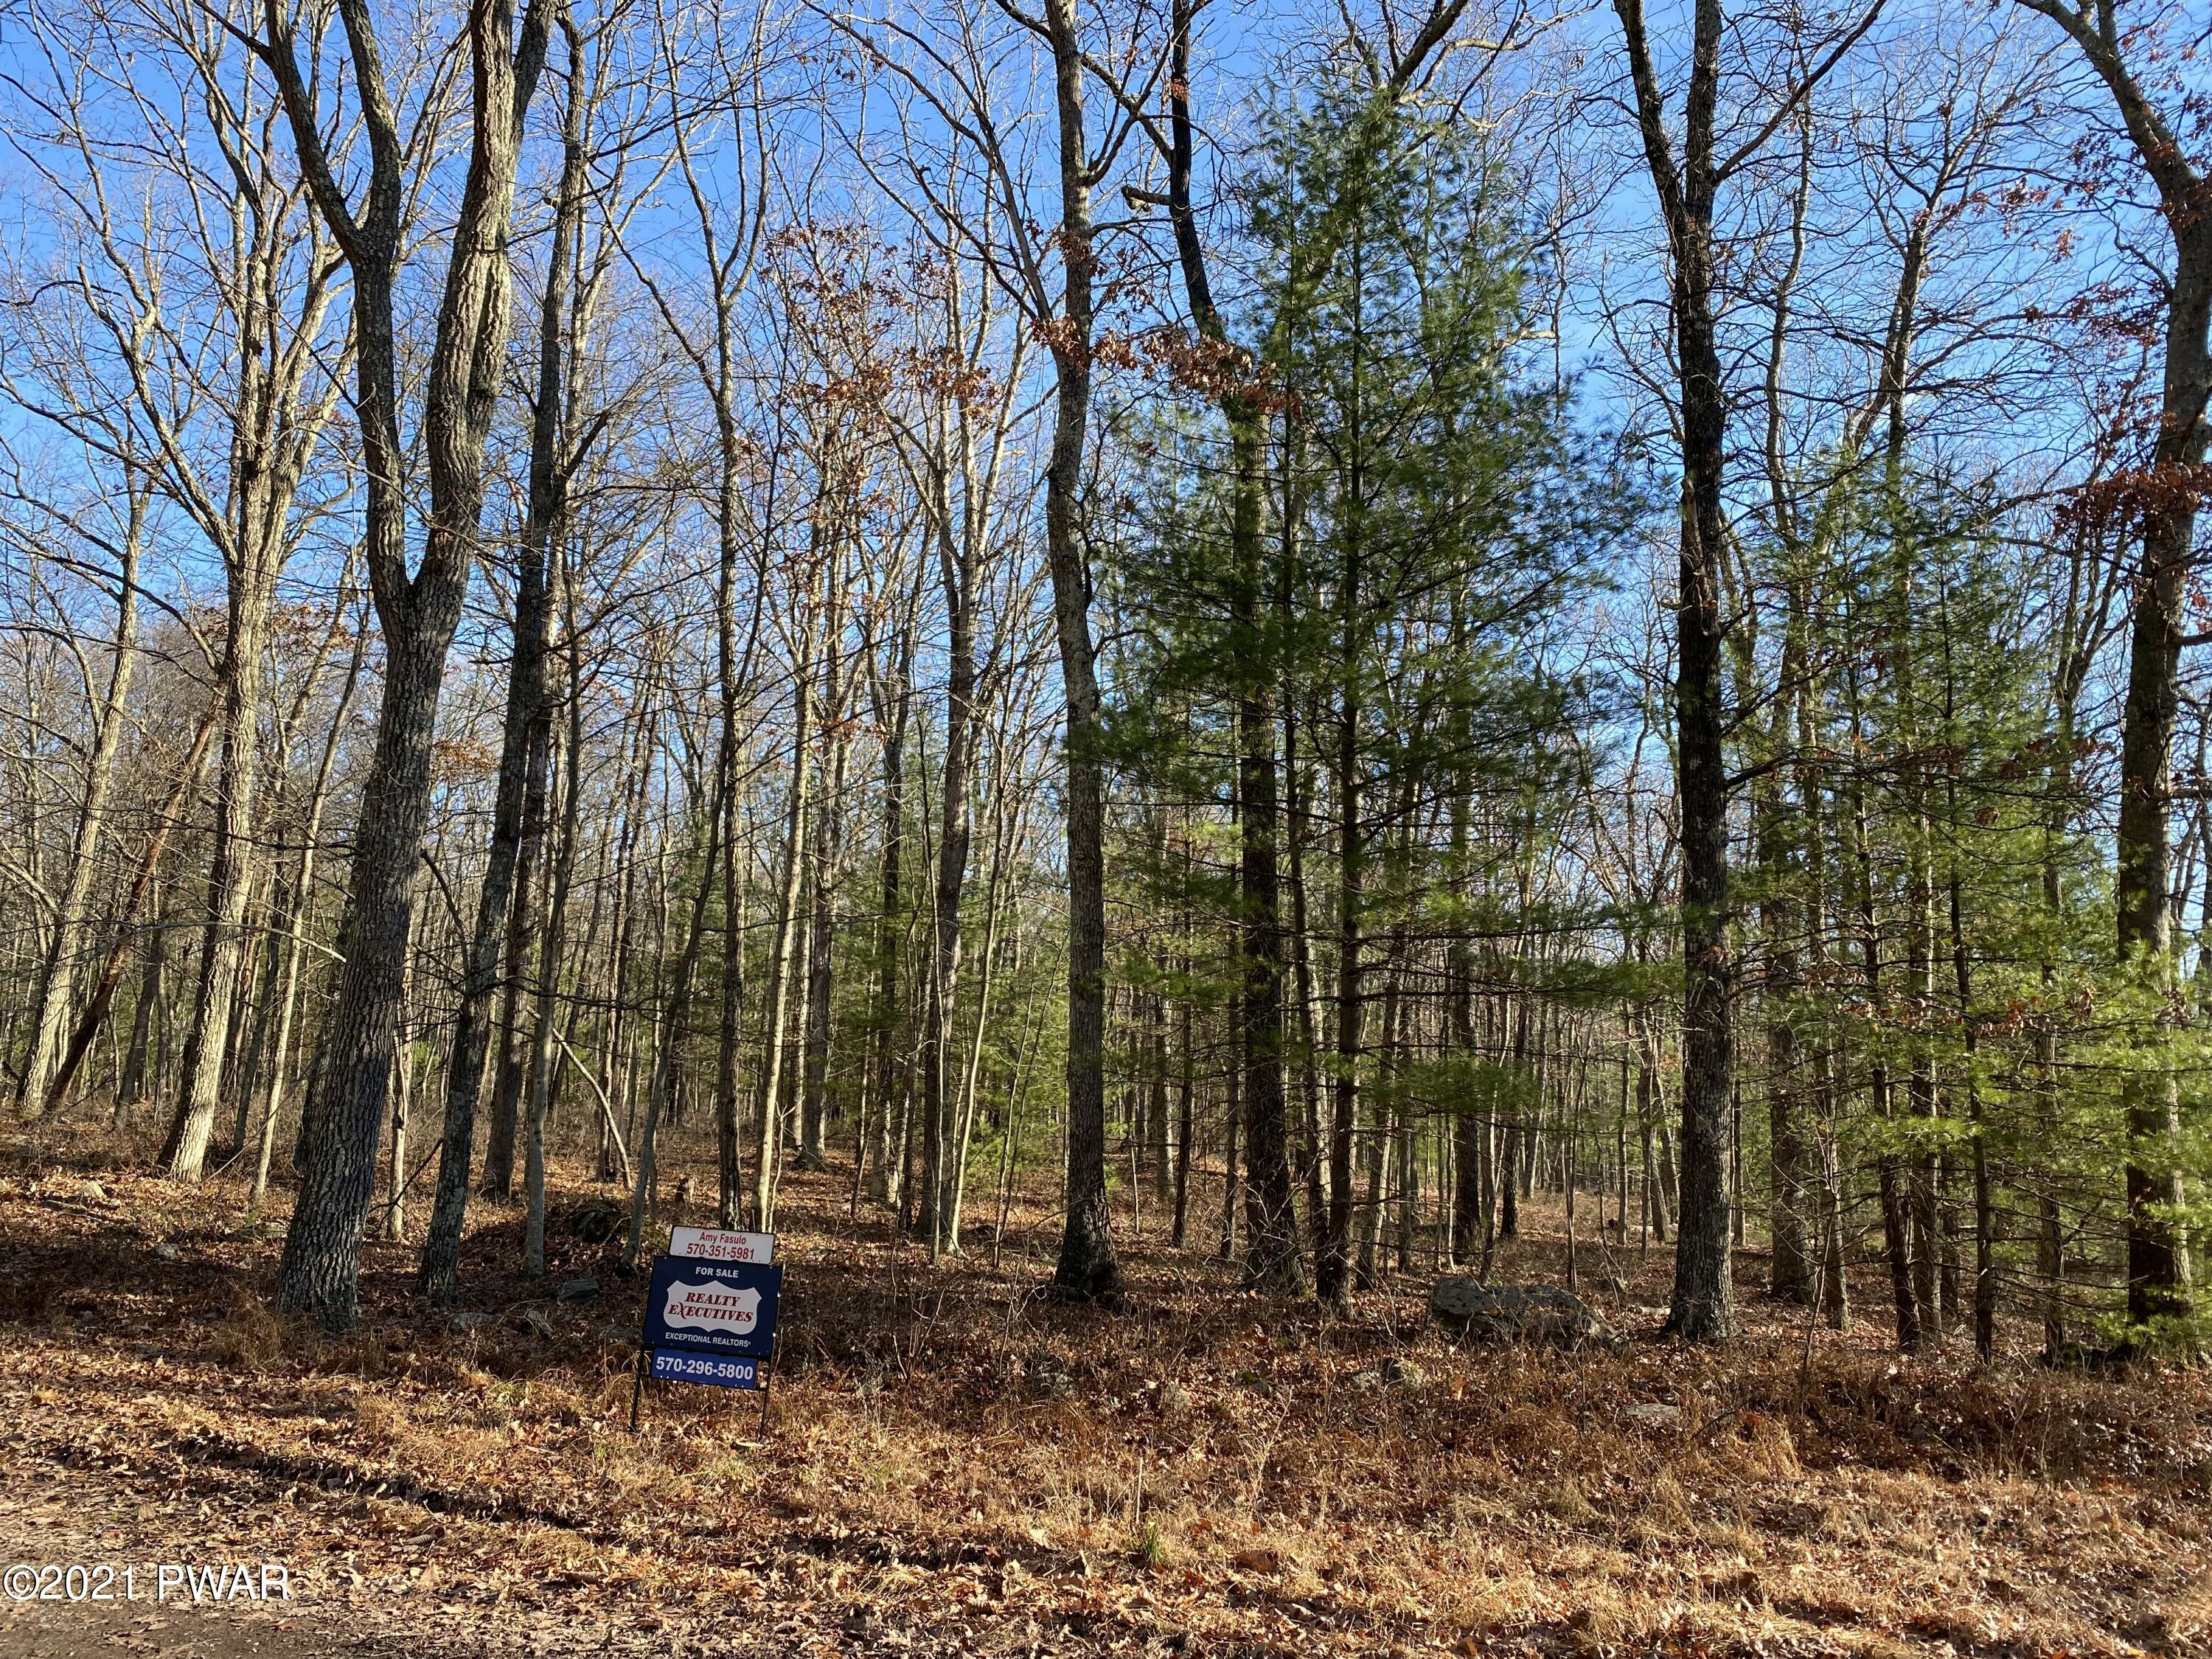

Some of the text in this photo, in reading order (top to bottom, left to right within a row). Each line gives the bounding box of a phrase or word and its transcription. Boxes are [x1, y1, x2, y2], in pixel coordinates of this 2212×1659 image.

[700, 1232, 746, 1245] Amy Fasulo
[686, 1243, 754, 1260] 570-351-5981
[695, 1267, 739, 1278] FOR SALE
[685, 1292, 740, 1307] REALTY
[667, 1302, 753, 1322] EXECUTIVES
[665, 1332, 712, 1343] EXCEPTIONAL
[655, 1356, 754, 1380] 570-296-5800
